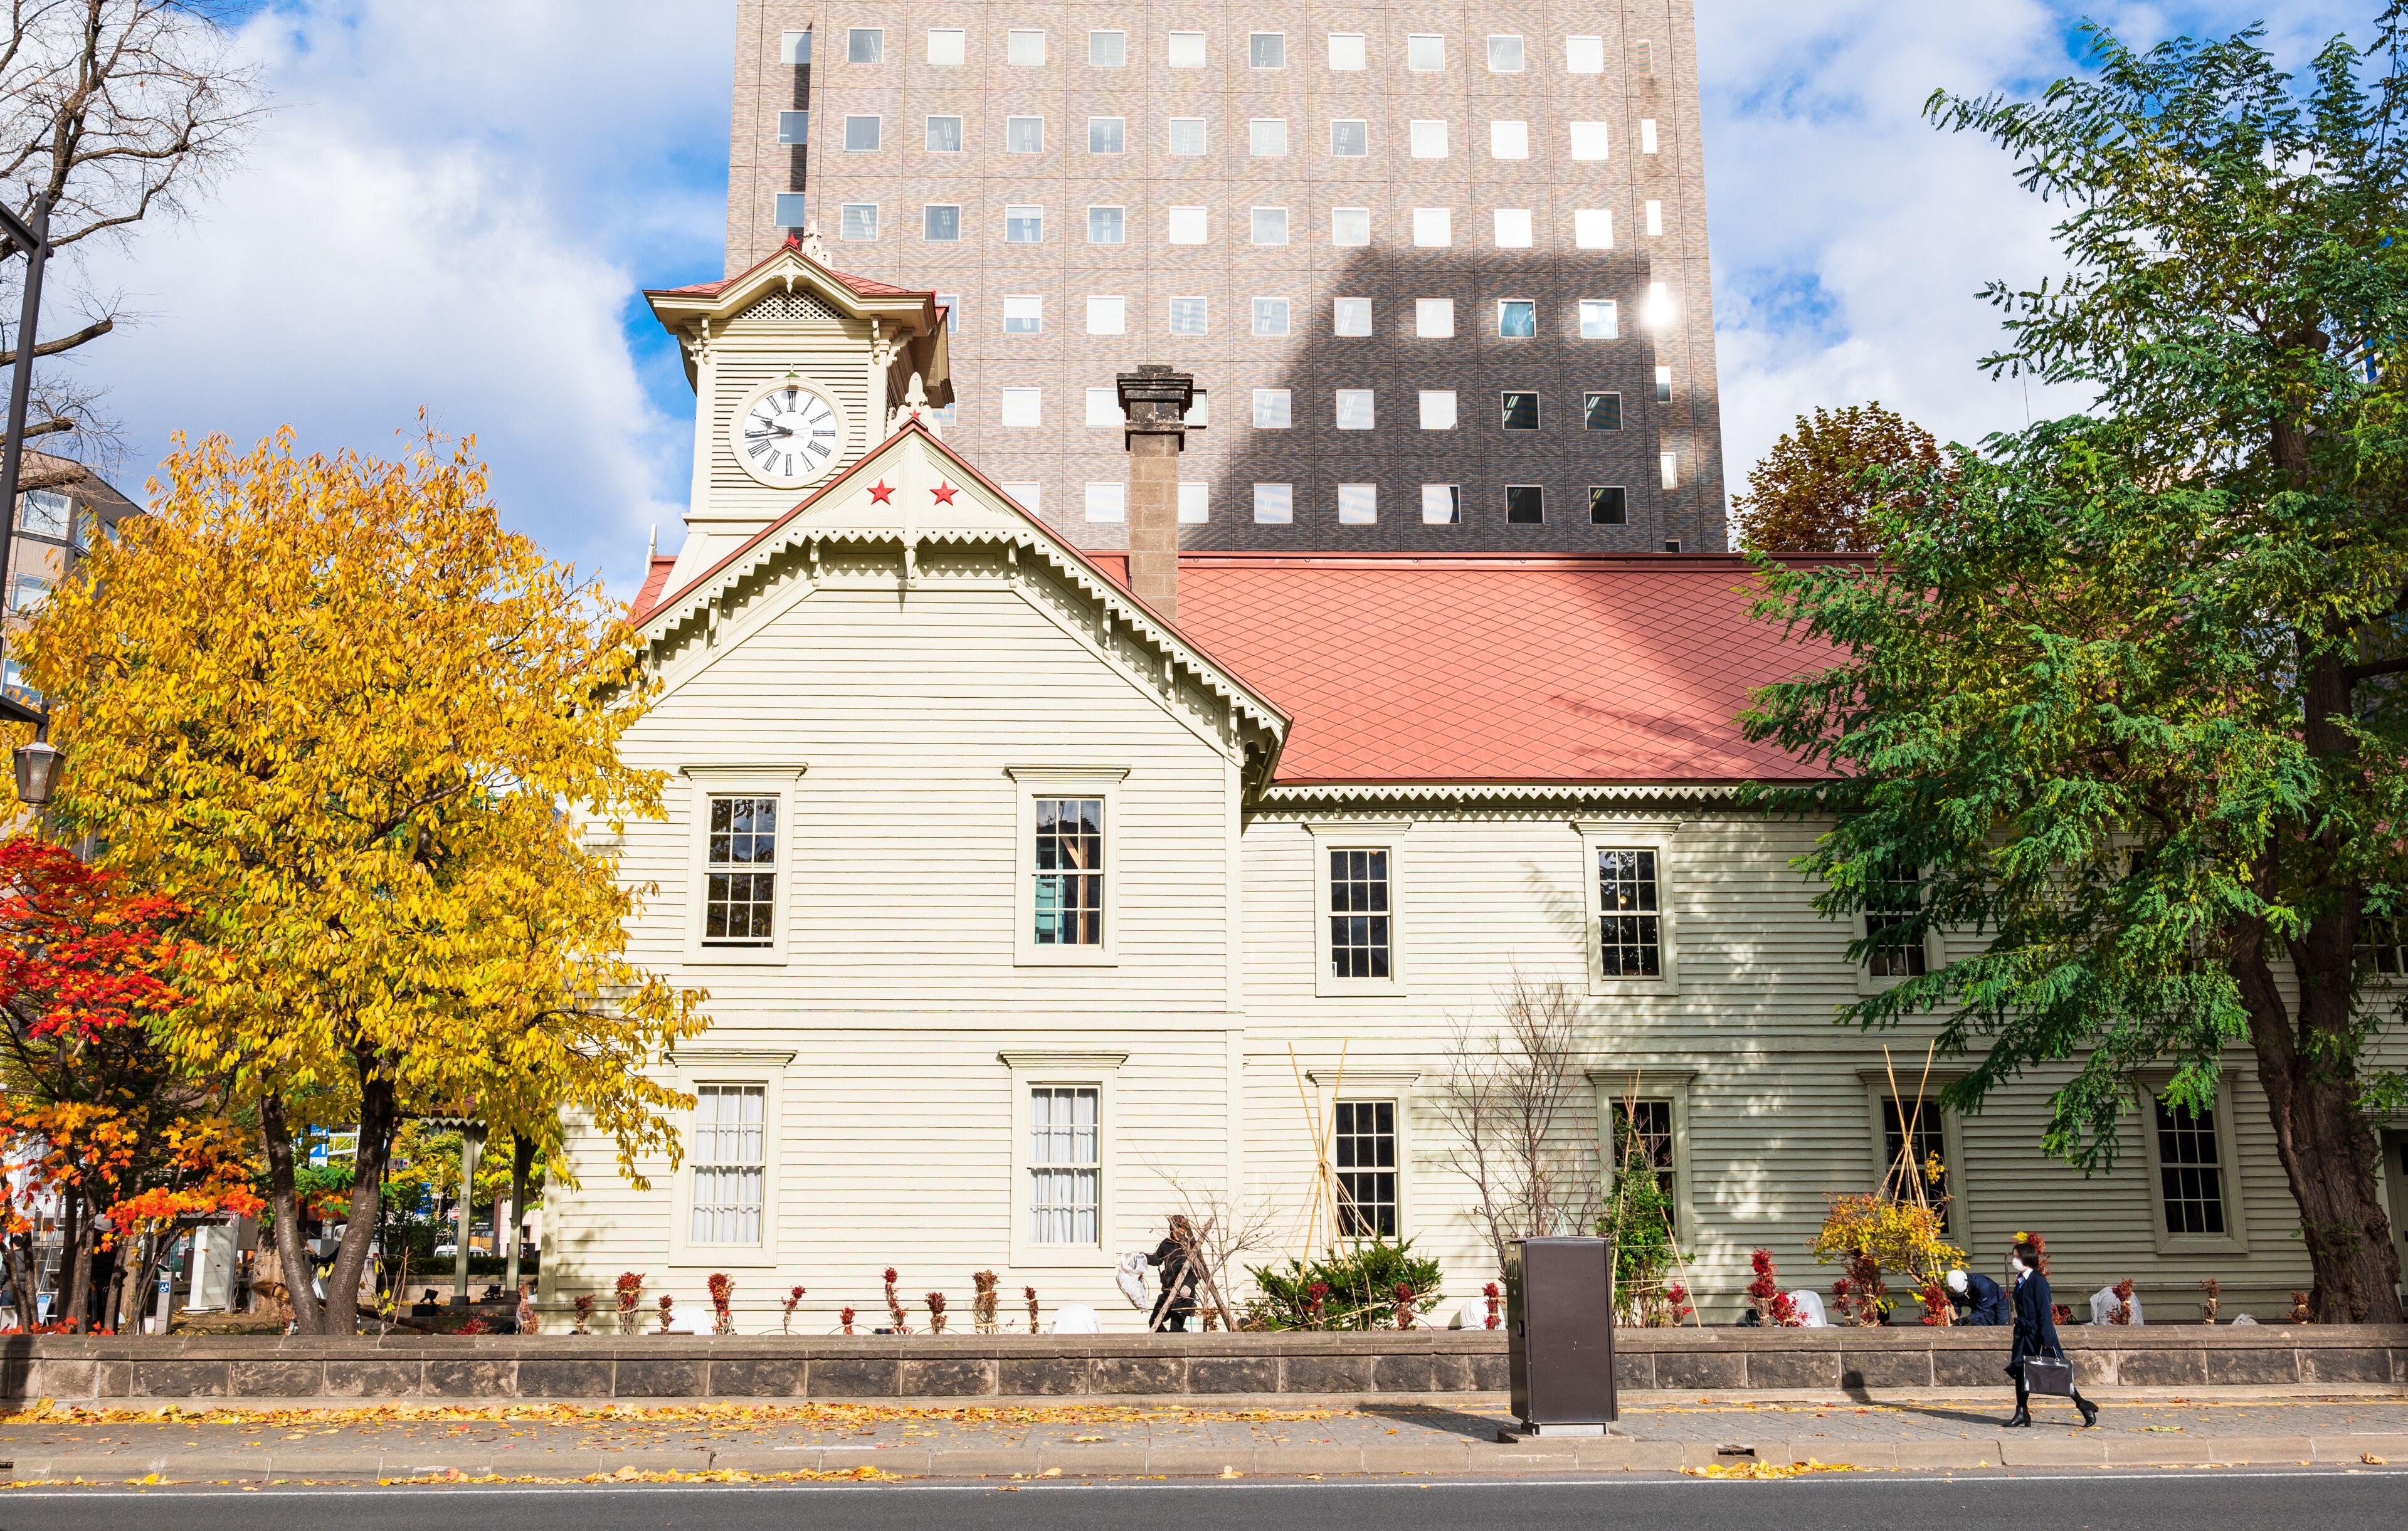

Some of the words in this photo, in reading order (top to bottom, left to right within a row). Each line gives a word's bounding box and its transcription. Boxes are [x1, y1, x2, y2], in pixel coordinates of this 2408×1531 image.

[766, 395, 783, 416] XI
[786, 391, 796, 412] XII
[801, 396, 816, 416] I
[810, 410, 831, 424] II
[748, 439, 772, 459] VIII
[807, 440, 832, 458] IIII
[763, 450, 781, 471] VII
[785, 454, 793, 476] VI
[801, 451, 815, 471] V
